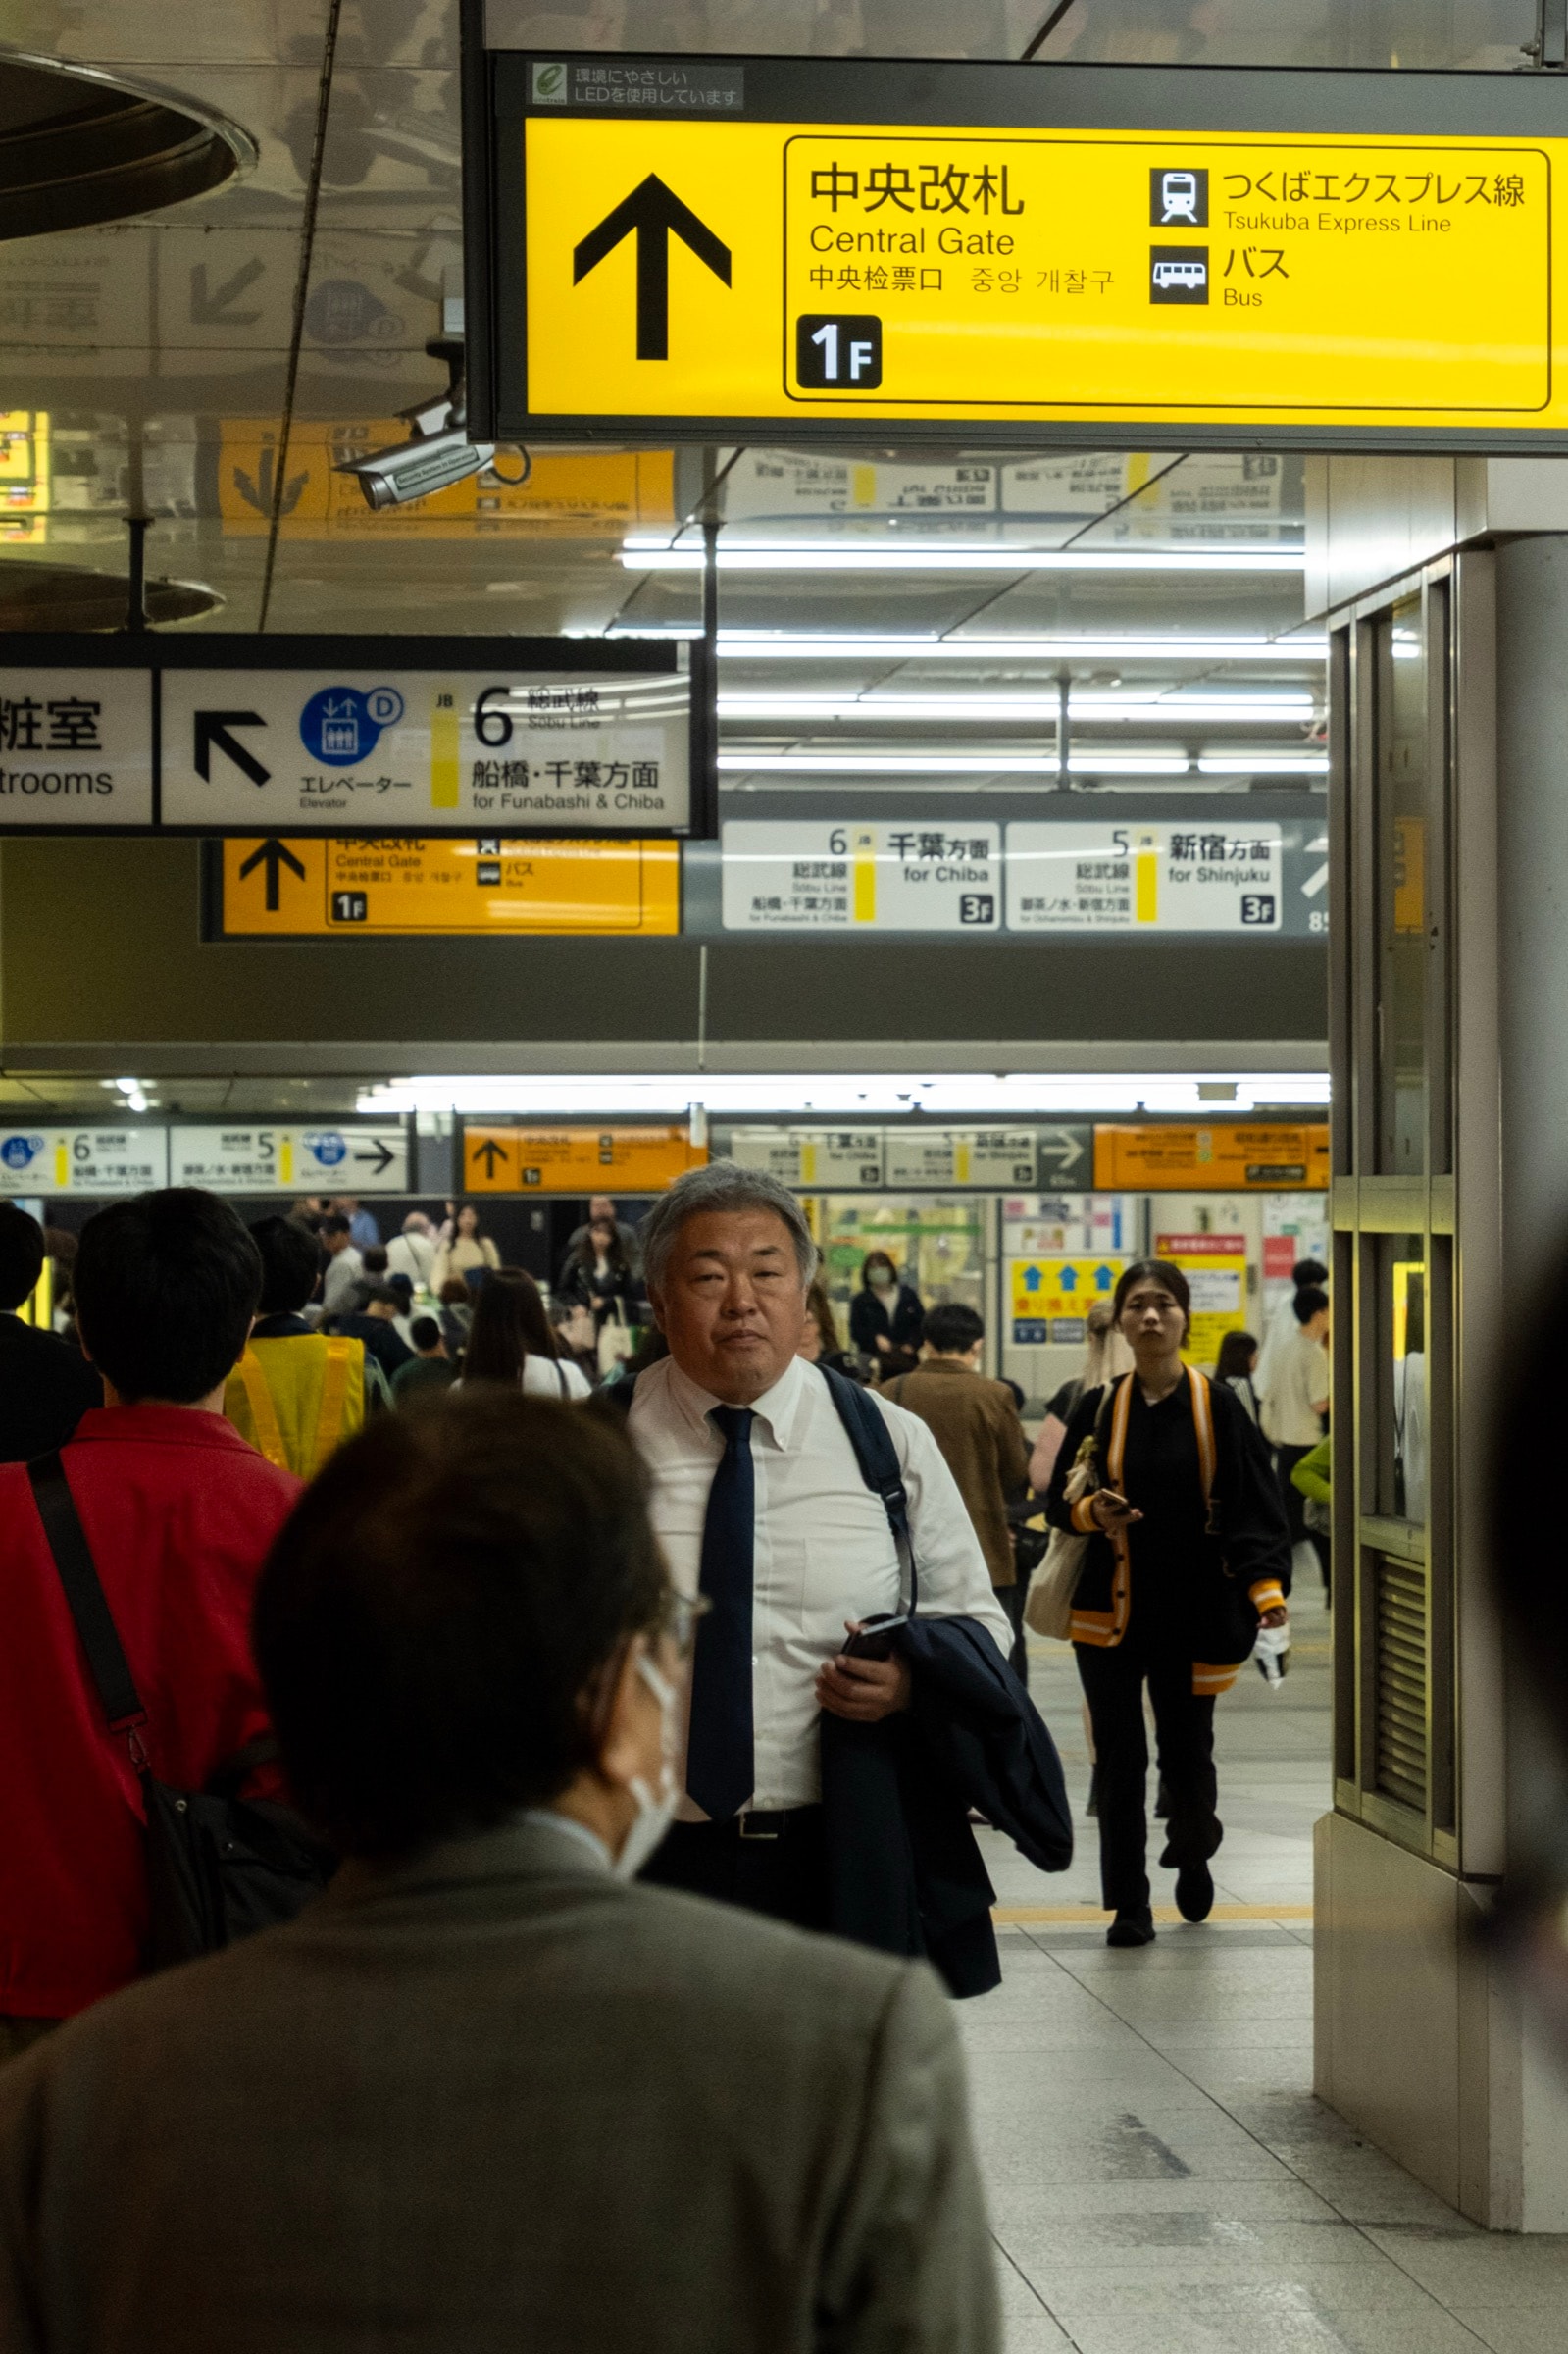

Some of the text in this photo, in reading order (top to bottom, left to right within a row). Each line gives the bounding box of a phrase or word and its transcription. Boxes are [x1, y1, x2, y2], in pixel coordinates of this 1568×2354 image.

[576, 68, 687, 85] 環境にやさしい
[575, 87, 736, 105] LEDを使用しています
[811, 162, 1025, 215] 中央改札
[1223, 171, 1525, 207] つくばエクスプレス線
[1223, 211, 1451, 234] Tsukuba Express Line
[809, 225, 1015, 255] Central Gate
[1223, 246, 1290, 279] バス
[809, 264, 943, 291] 中央检票口
[971, 268, 1115, 294] 중앙 개찰구
[1224, 288, 1263, 307] Bus
[811, 324, 873, 380] 1F
[436, 694, 454, 708] JB
[475, 686, 513, 747] 6
[570, 714, 600, 729] Line
[299, 776, 412, 793] エレベーター
[299, 796, 347, 809] Elevator
[473, 793, 665, 809] for Funabashi & Chiba
[830, 828, 847, 855] 6
[887, 833, 989, 861] 千葉方面
[1112, 830, 1129, 857] 5
[1170, 834, 1270, 861] 新宿方面
[335, 854, 422, 867] Central Gate
[904, 866, 988, 882] for Chiba
[1169, 867, 1270, 886] for Shinjuku
[337, 895, 364, 919] 1F
[963, 896, 990, 921] 3F
[1244, 897, 1272, 921] 3F
[74, 1134, 90, 1161] 6
[258, 1131, 274, 1159] 5
